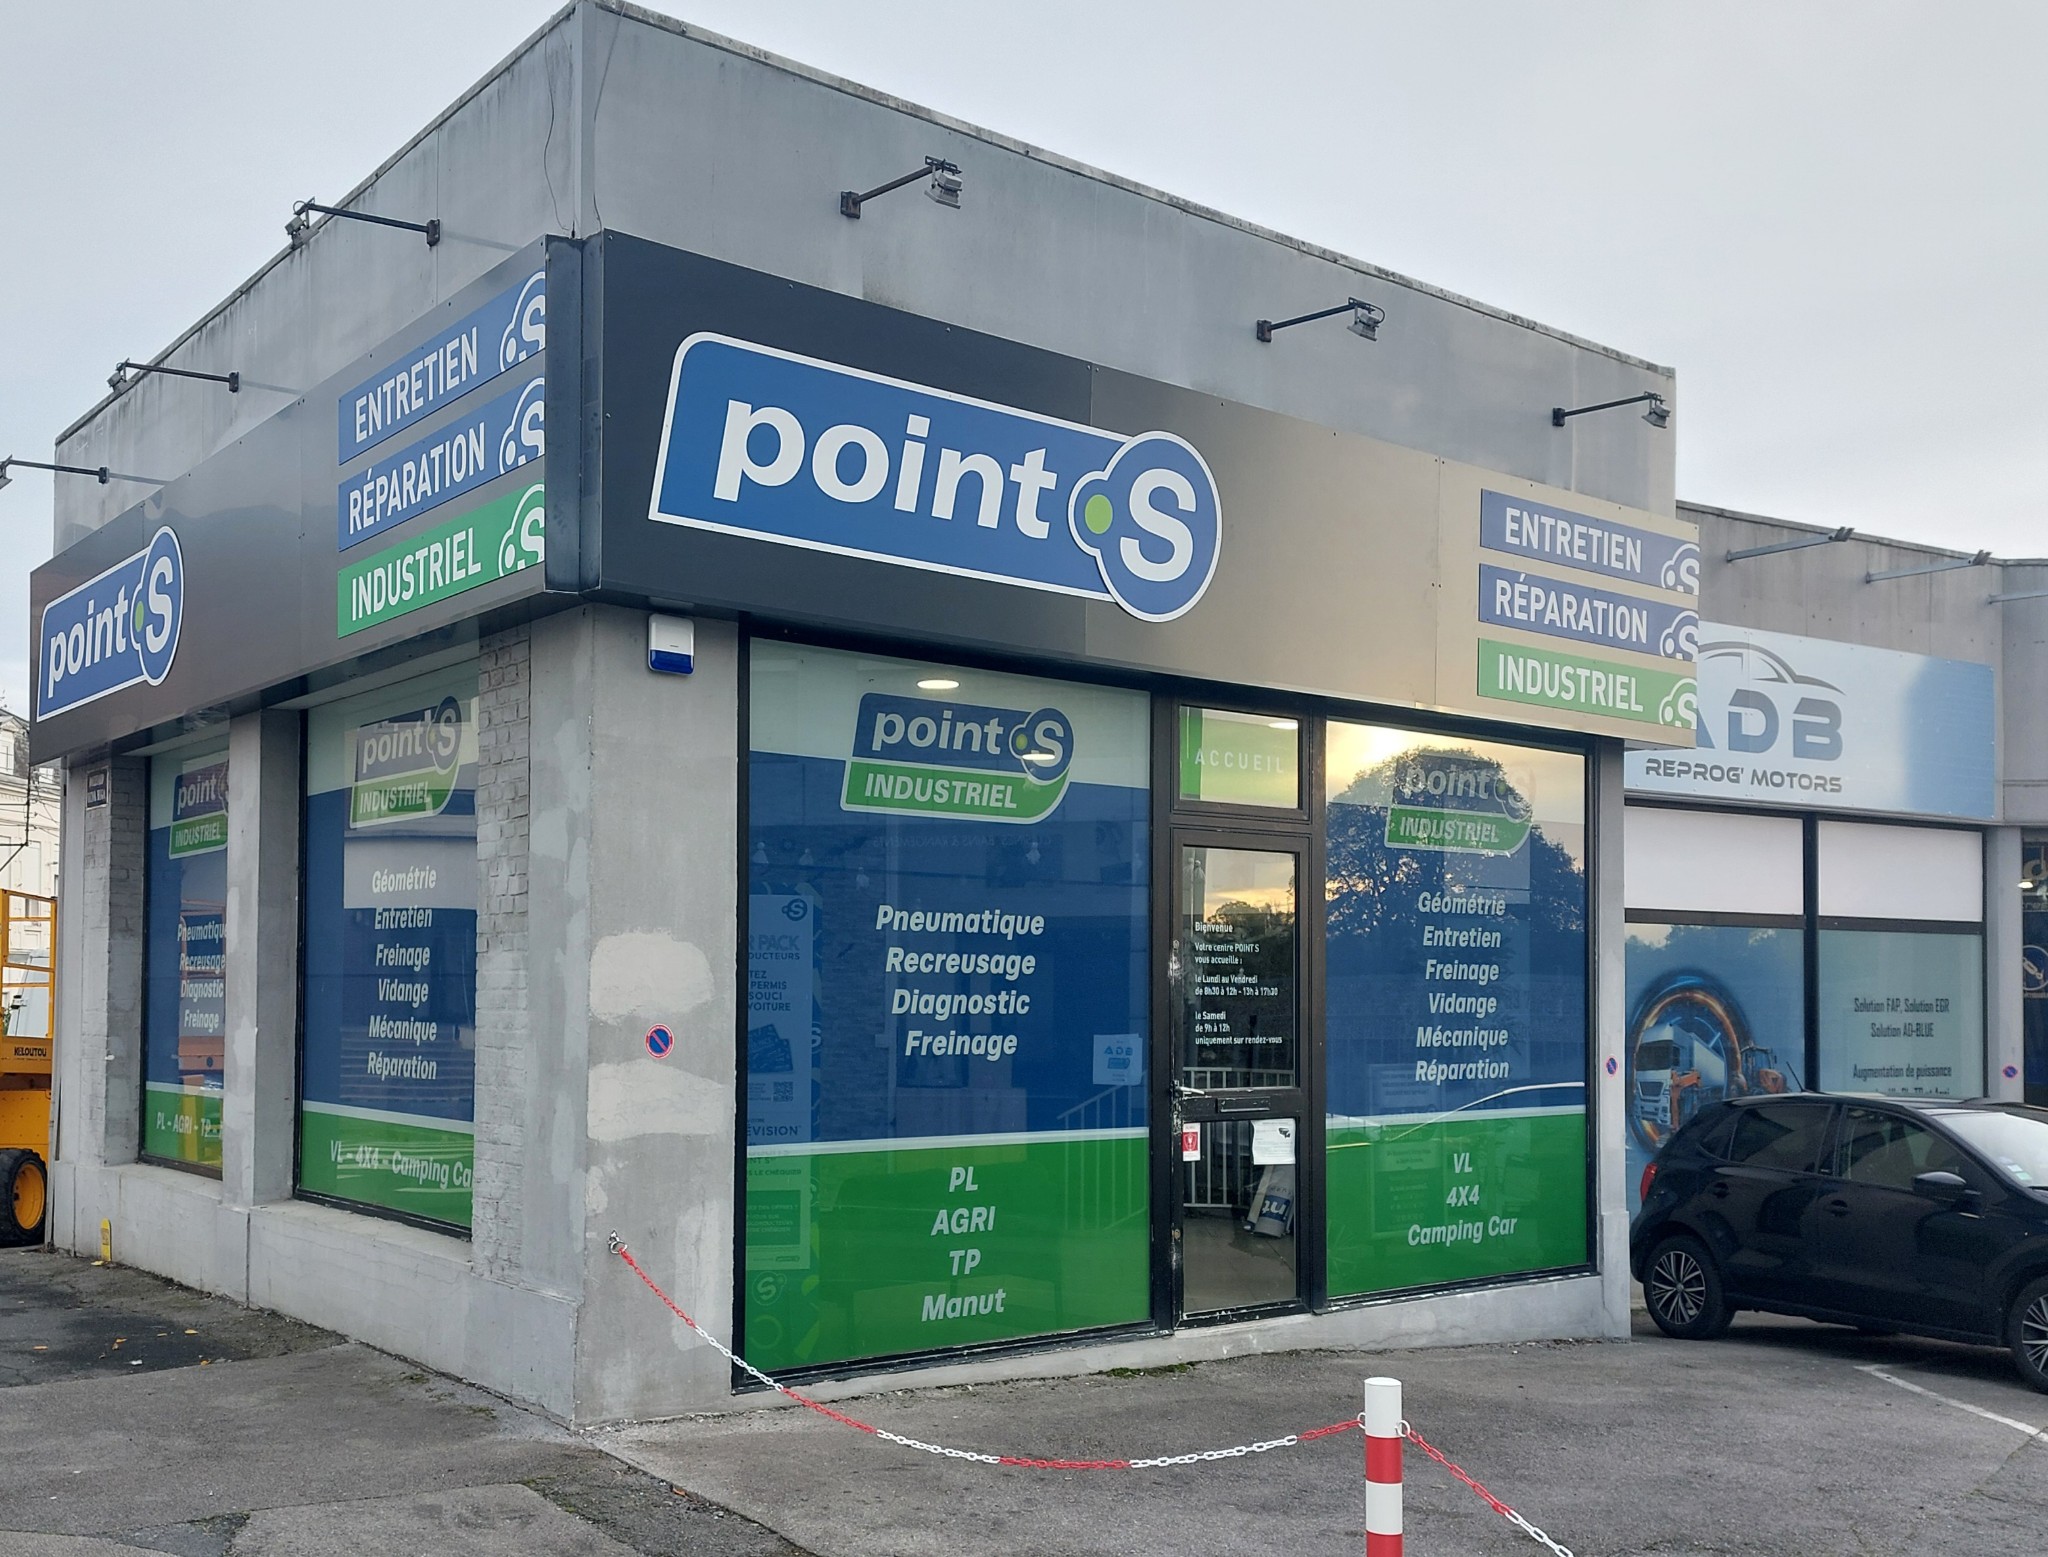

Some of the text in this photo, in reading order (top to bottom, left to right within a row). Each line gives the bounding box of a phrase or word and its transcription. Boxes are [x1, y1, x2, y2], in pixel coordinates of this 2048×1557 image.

[355, 326, 478, 443] ENTRETIEN
[349, 421, 486, 535] RÉPARATION
[713, 399, 1196, 583] point S
[1505, 507, 1642, 574] ENTRETIEN
[352, 527, 481, 621] INDUSTRIEL
[1495, 573, 1647, 644] RÉPARATION
[48, 556, 173, 698] point S
[1499, 653, 1643, 712] INDUSTRIEL
[362, 708, 457, 774] point S
[872, 710, 1065, 767] point S
[1195, 748, 1284, 773] ACCUEIL
[1400, 764, 1491, 800] point
[1646, 758, 1843, 793] REPROG' MOTORS
[177, 775, 217, 815] point
[360, 781, 431, 814] INDUSTRIEL
[864, 773, 1018, 809] INDUSTRIEL
[175, 822, 221, 847] INDUSTRIEL
[1400, 816, 1500, 843] INDUSTRIEL
[372, 865, 437, 893] Géométrie
[375, 904, 433, 930] Entretien
[1418, 892, 1506, 916] Géométrie
[876, 904, 1045, 940] Pneumatique
[1195, 921, 1233, 932] Bienvenue
[1194, 942, 1212, 952] Votre
[1213, 943, 1234, 952] centre
[1235, 943, 1255, 952] POINT
[1423, 926, 1501, 948] Entretien
[180, 953, 225, 974] Recreusage
[376, 943, 431, 972] Freinage
[885, 947, 1037, 981] Recreusage
[1211, 955, 1239, 964] accueille
[750, 981, 787, 990] PERMIS
[1194, 975, 1201, 983] le
[1202, 975, 1221, 984] Lundi
[1230, 975, 1258, 984] Vendredi
[1425, 959, 1500, 985] Freinage
[181, 979, 224, 1002] Diagnostic
[378, 978, 429, 1008] Vidange
[1194, 987, 1203, 995] de
[1204, 987, 1220, 996] 8h30
[1220, 986, 1225, 996] à
[1226, 987, 1238, 996] 12h
[1243, 987, 1254, 996] 13h
[1254, 986, 1259, 996] à
[1260, 987, 1279, 996] 17h30
[892, 989, 1031, 1021] Diagnostic
[1194, 1011, 1226, 1020] le Samedi
[1428, 992, 1497, 1018] Vidange
[1854, 997, 1885, 1013] Solution
[1904, 998, 1934, 1013] Solution
[183, 1009, 220, 1033] Freinage
[368, 1015, 437, 1046] Mécanique
[1194, 1023, 1231, 1033] de 9h à 12h
[1871, 1022, 1901, 1037] Solution
[905, 1030, 1018, 1062] Freinage
[1194, 1035, 1283, 1046] uniquement sur rendez-vous
[1416, 1025, 1509, 1050] Mécanique
[367, 1052, 437, 1081] Réparation
[1415, 1059, 1510, 1085] Réparation
[1853, 1063, 1952, 1081] Augmentation de puissance
[156, 1111, 165, 1130] PL
[173, 1114, 193, 1134] AGRI
[331, 1140, 343, 1163] VL
[355, 1146, 379, 1169] 4X4
[392, 1151, 449, 1189] Camping
[1453, 1153, 1473, 1173] VL
[949, 1166, 979, 1192] PL
[1446, 1184, 1480, 1207] 4X4
[930, 1206, 996, 1236] AGRI
[1408, 1215, 1518, 1246] Camping Car
[949, 1249, 981, 1276] TP
[921, 1288, 1006, 1321] Manut
